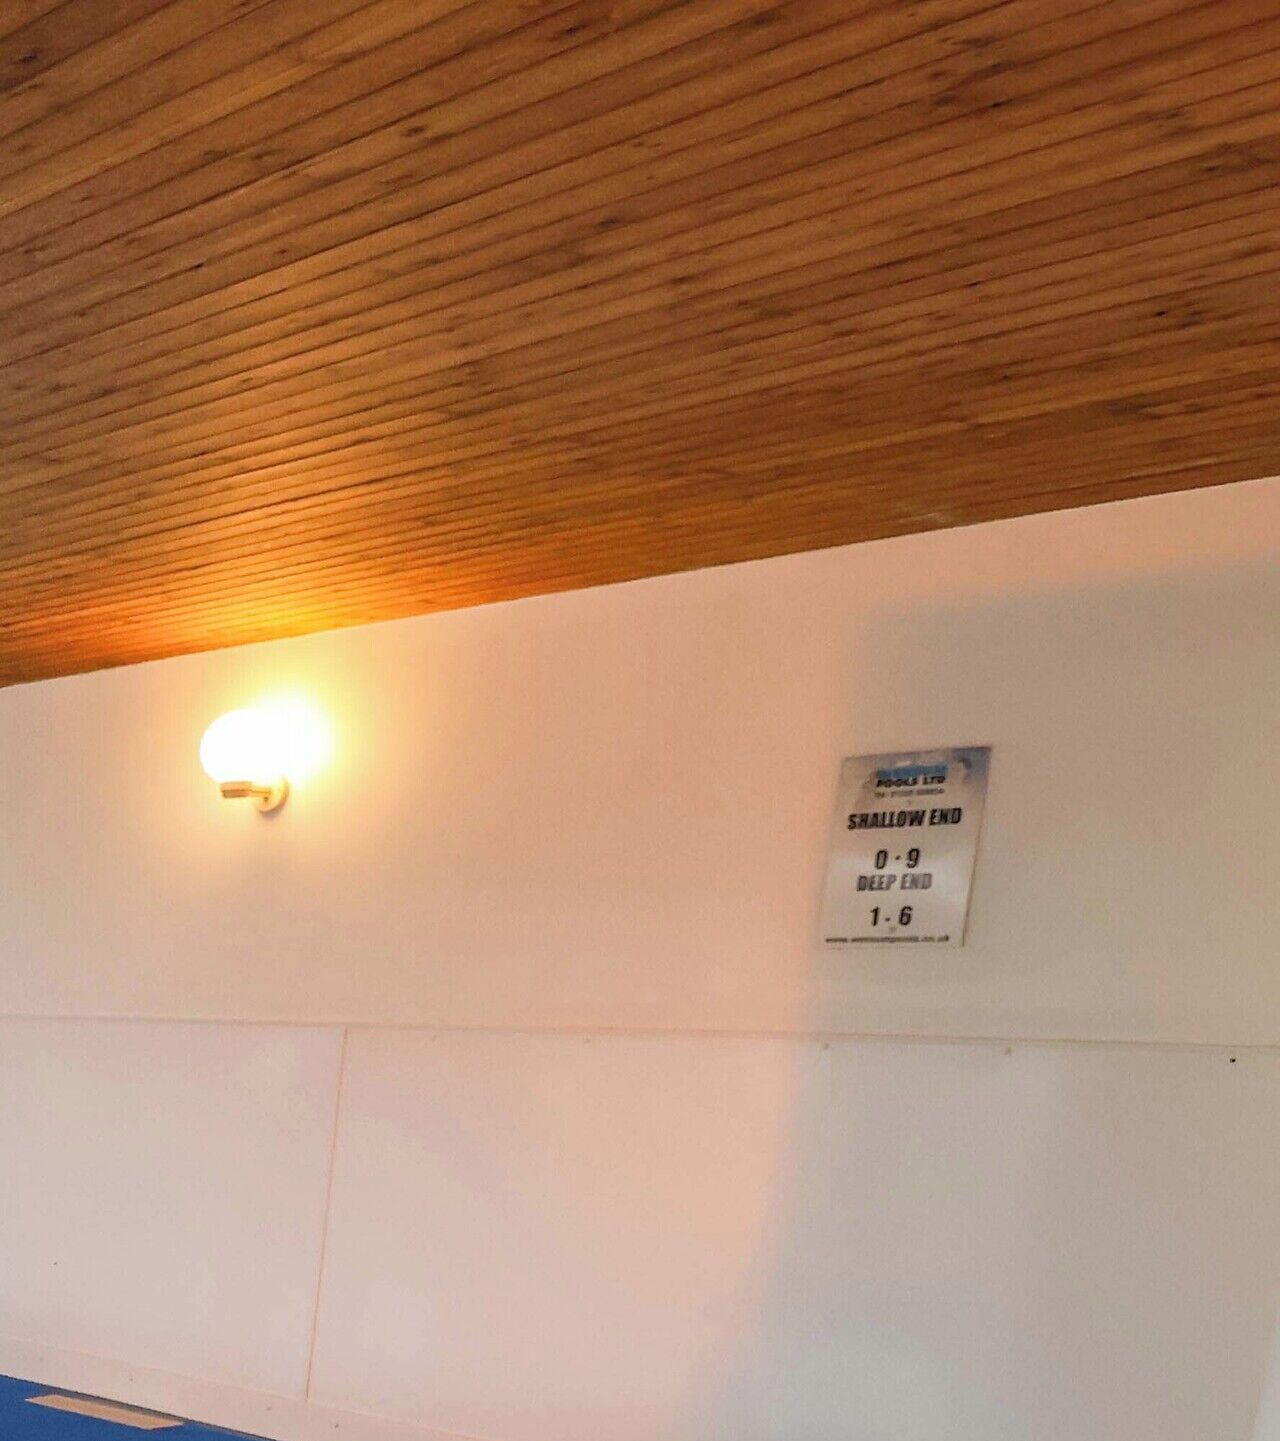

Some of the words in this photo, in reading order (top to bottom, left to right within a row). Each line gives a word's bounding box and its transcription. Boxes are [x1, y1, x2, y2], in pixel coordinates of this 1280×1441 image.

[847, 808, 926, 830] SHALLOW
[929, 807, 963, 826] END
[856, 874, 897, 892] DEEP
[900, 873, 933, 890] END
